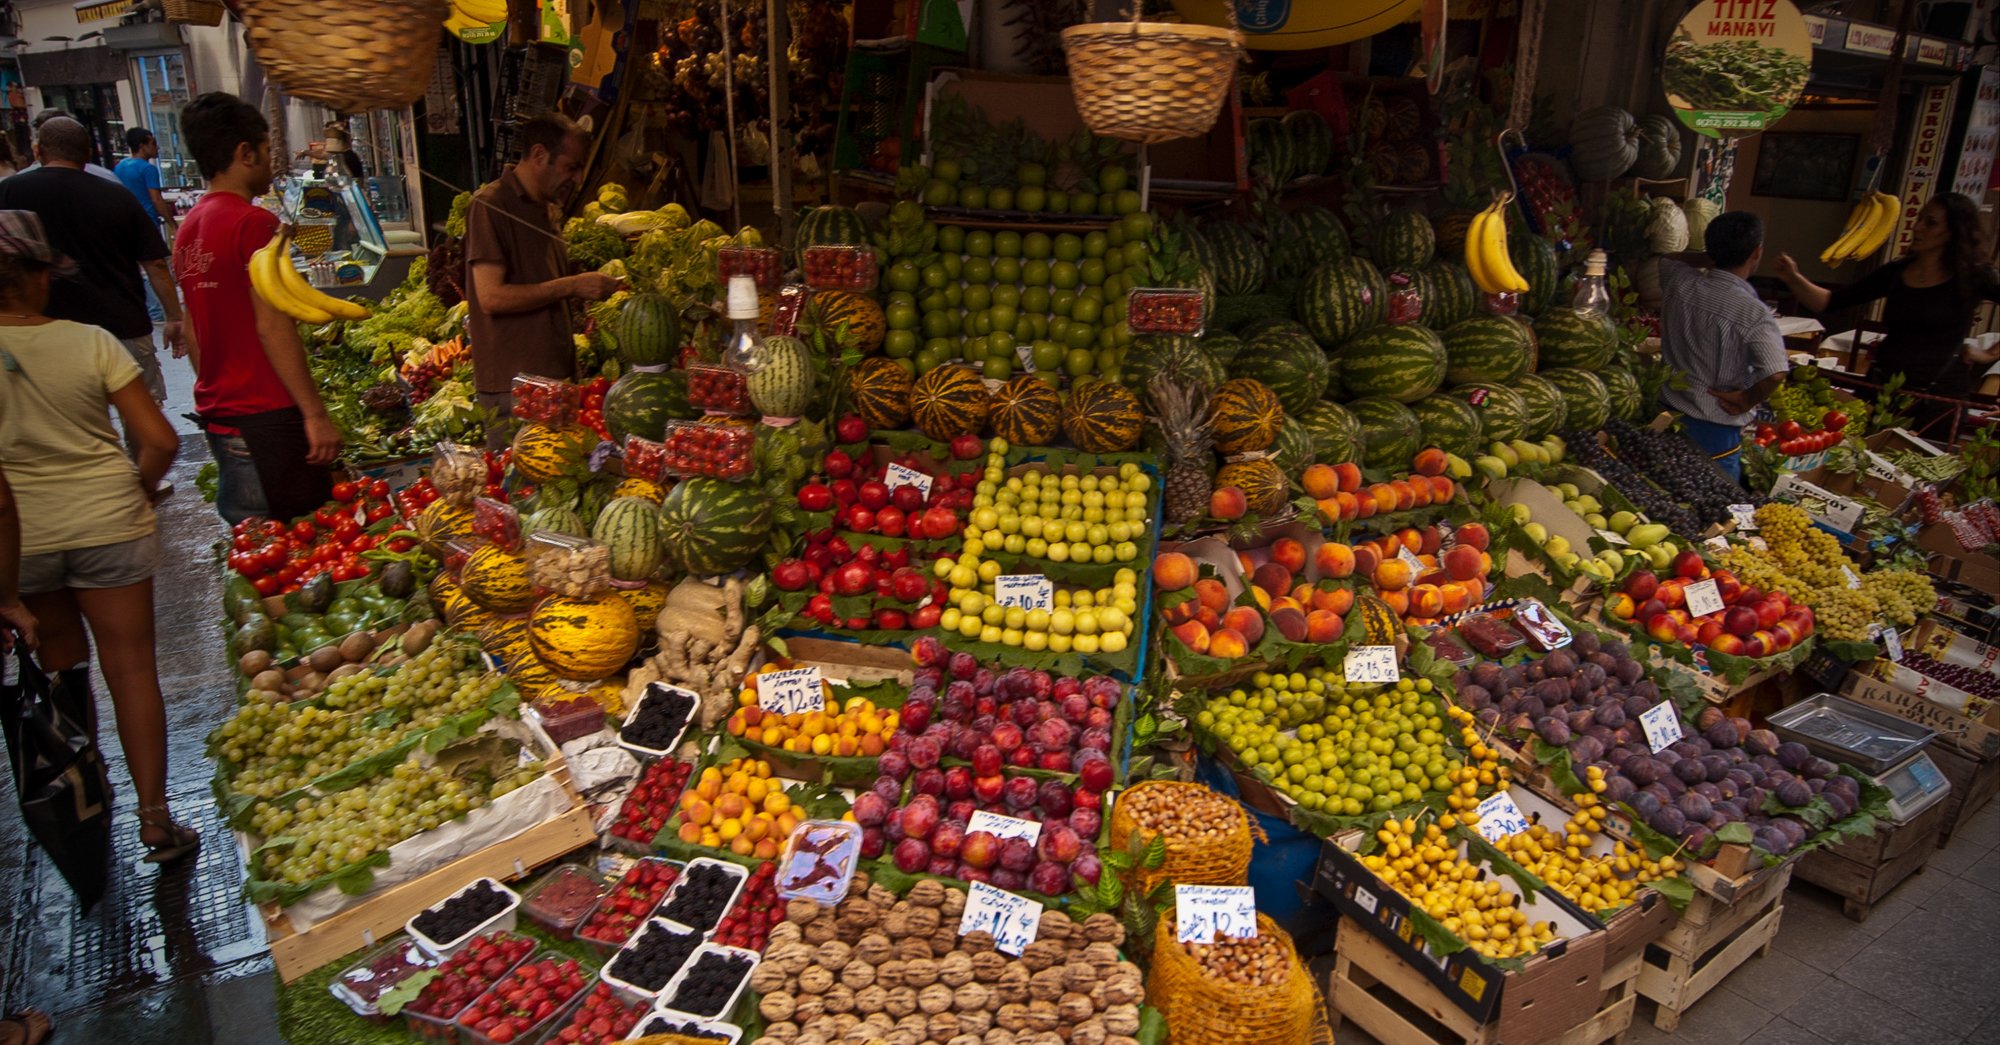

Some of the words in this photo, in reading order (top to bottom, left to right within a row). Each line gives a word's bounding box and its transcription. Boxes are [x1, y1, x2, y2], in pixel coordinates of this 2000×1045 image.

[1915, 89, 1947, 167] HERGÜN
[788, 688, 807, 712] 12
[1493, 819, 1516, 834] 30
